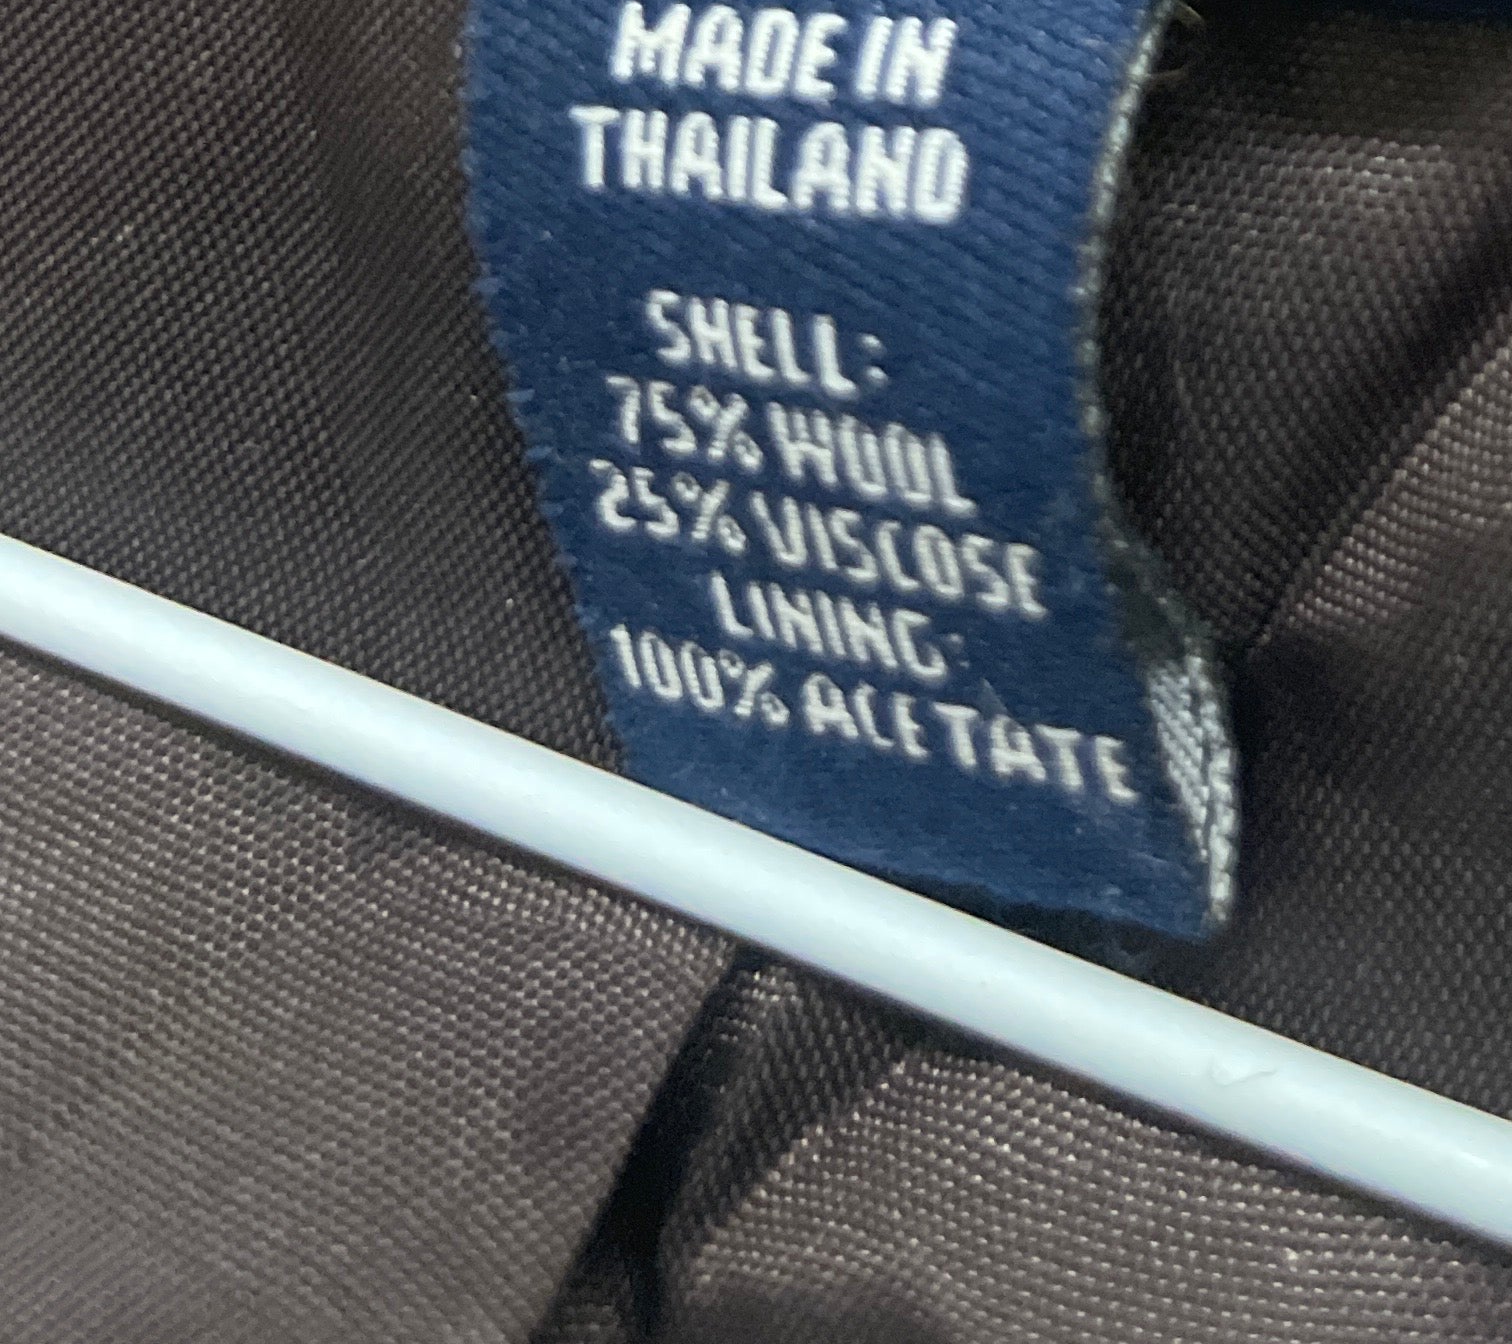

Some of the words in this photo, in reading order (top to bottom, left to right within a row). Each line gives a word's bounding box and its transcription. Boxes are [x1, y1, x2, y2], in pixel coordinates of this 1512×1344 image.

[608, 0, 848, 104] MADE
[853, 14, 958, 107] IN
[568, 105, 970, 222] THAILAND
[644, 289, 891, 399] SHELL:
[606, 374, 763, 471] 75%
[766, 398, 978, 516] WOOL
[588, 458, 747, 553] 25%
[748, 488, 1048, 618] VISCOSE
[609, 620, 791, 728] 100%
[800, 670, 1142, 804] ACETATE
